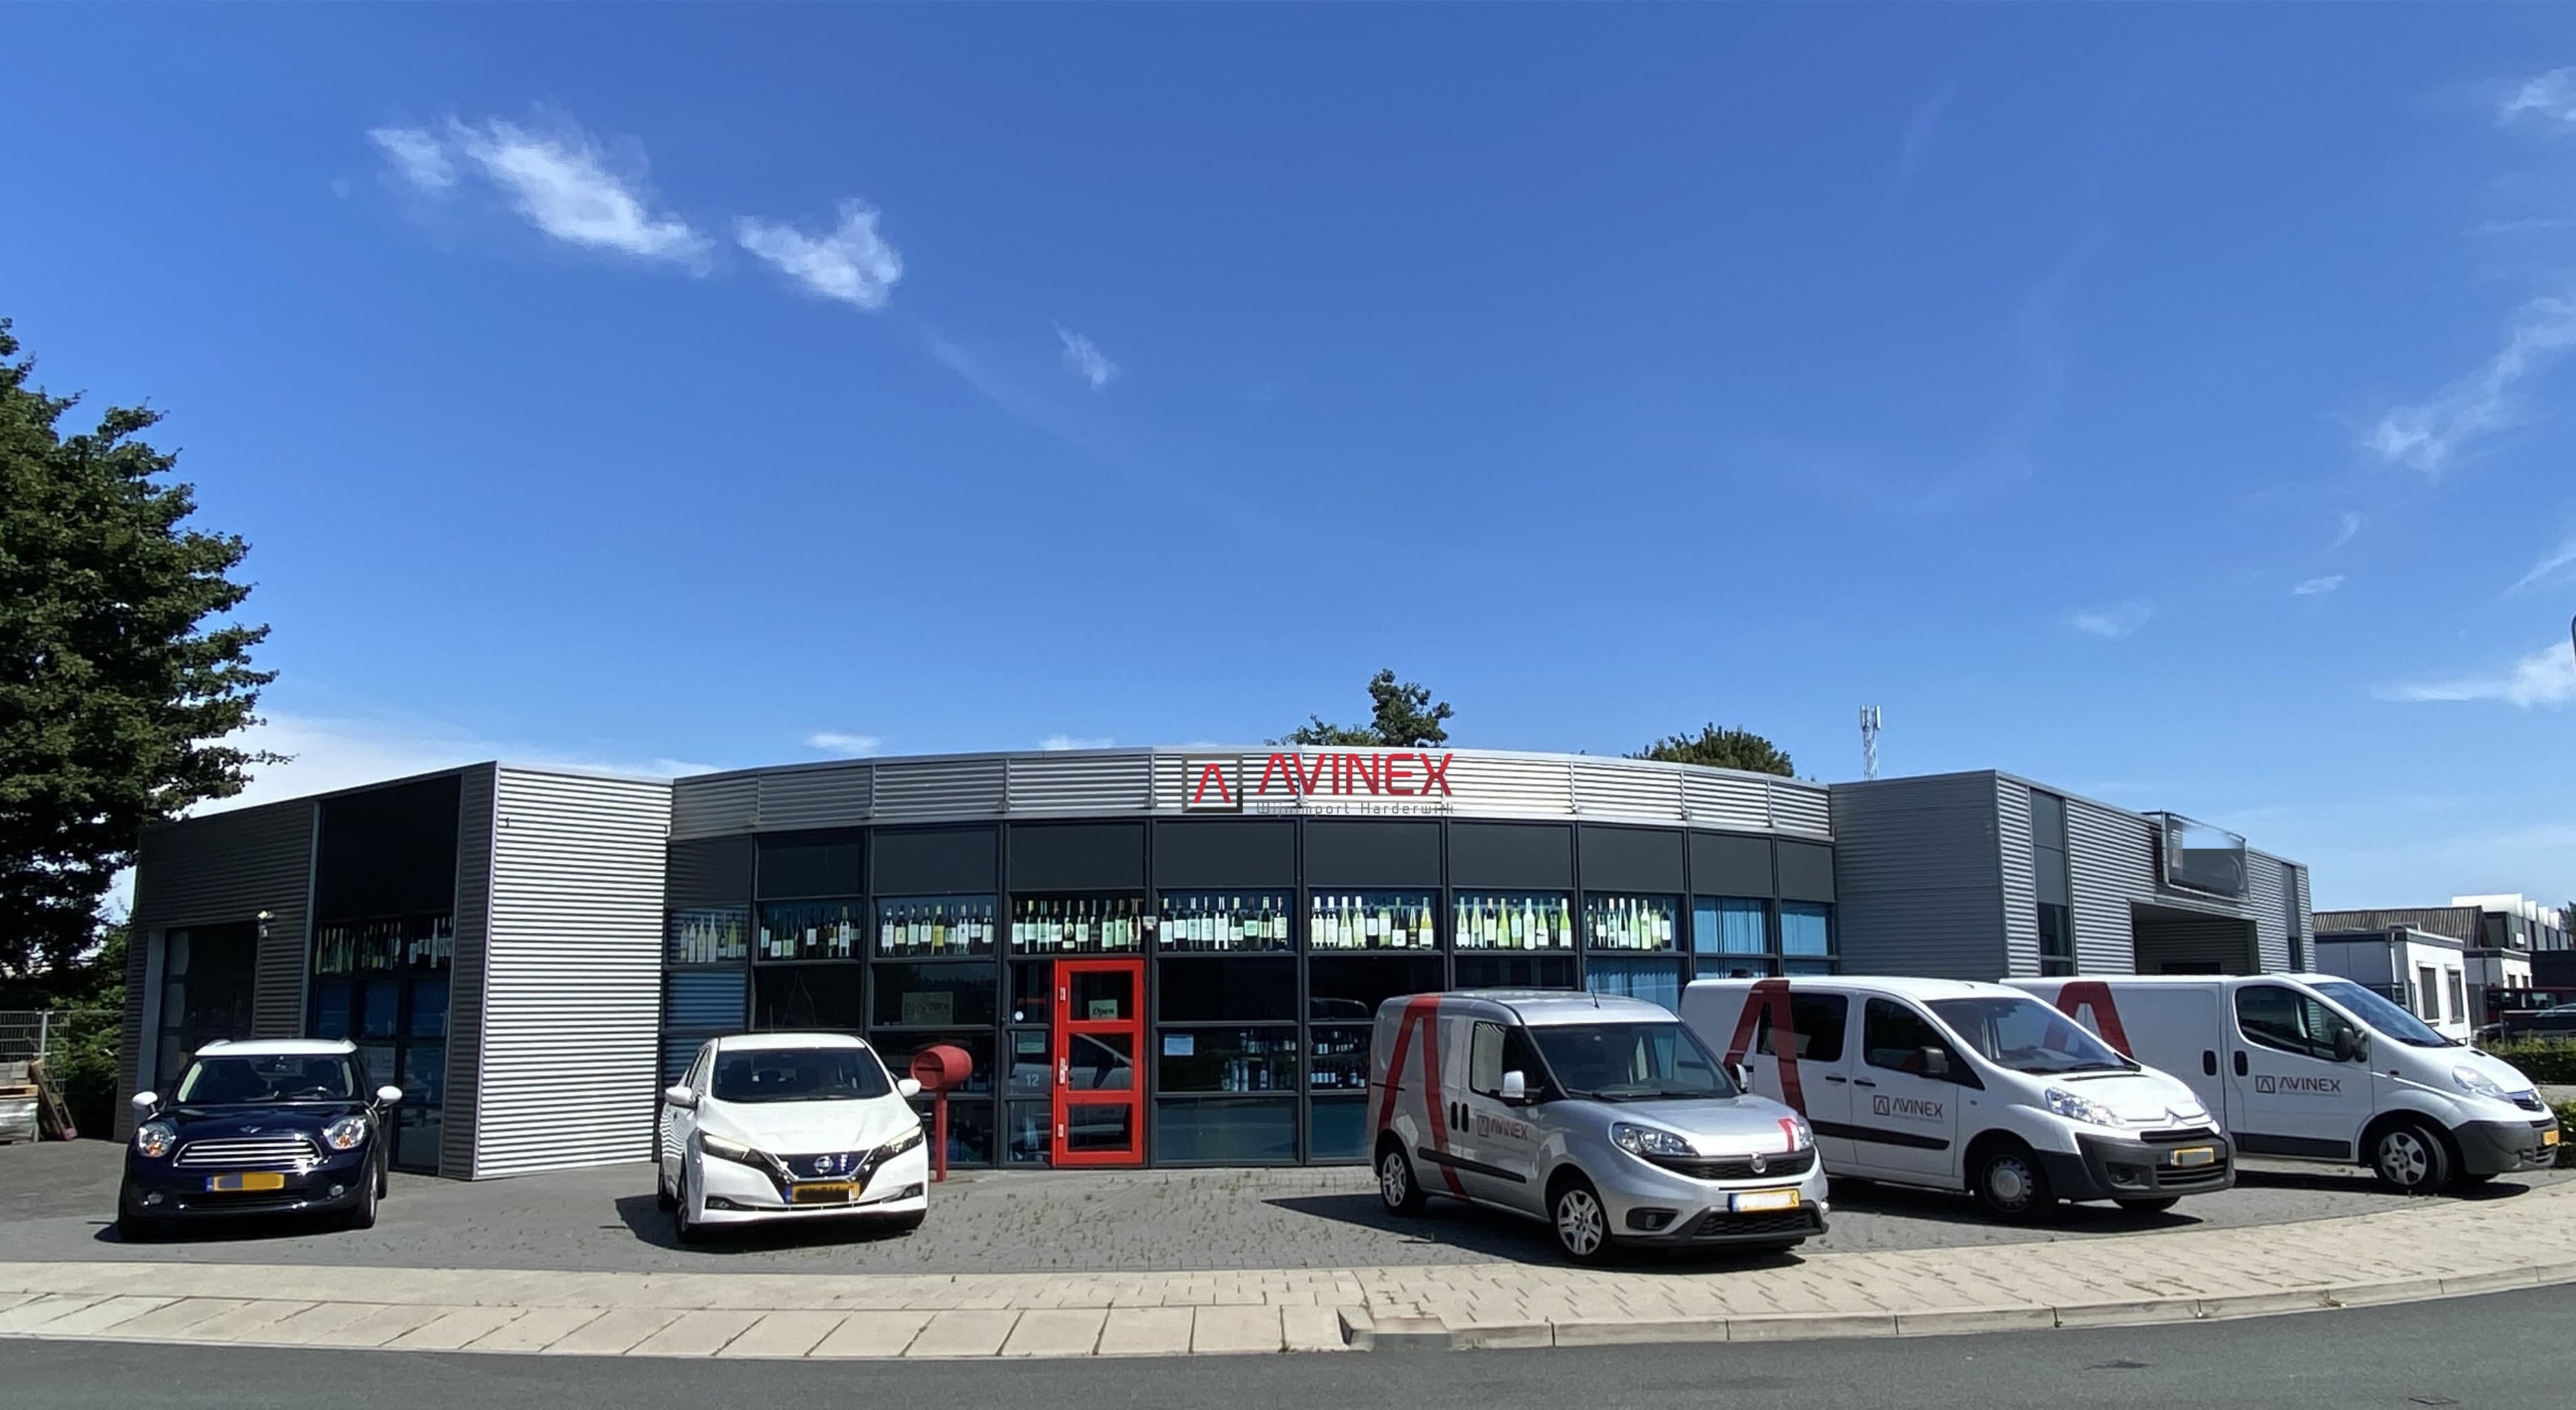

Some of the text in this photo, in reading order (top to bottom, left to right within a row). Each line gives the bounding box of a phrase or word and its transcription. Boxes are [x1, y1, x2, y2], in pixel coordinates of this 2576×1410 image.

[1257, 754, 1453, 795] AVINEX
[1093, 1007, 1115, 1017] Open
[1025, 1074, 1040, 1086] 12
[2279, 1077, 2342, 1092] AVINEX
[1893, 1097, 1944, 1119] AVINEX
